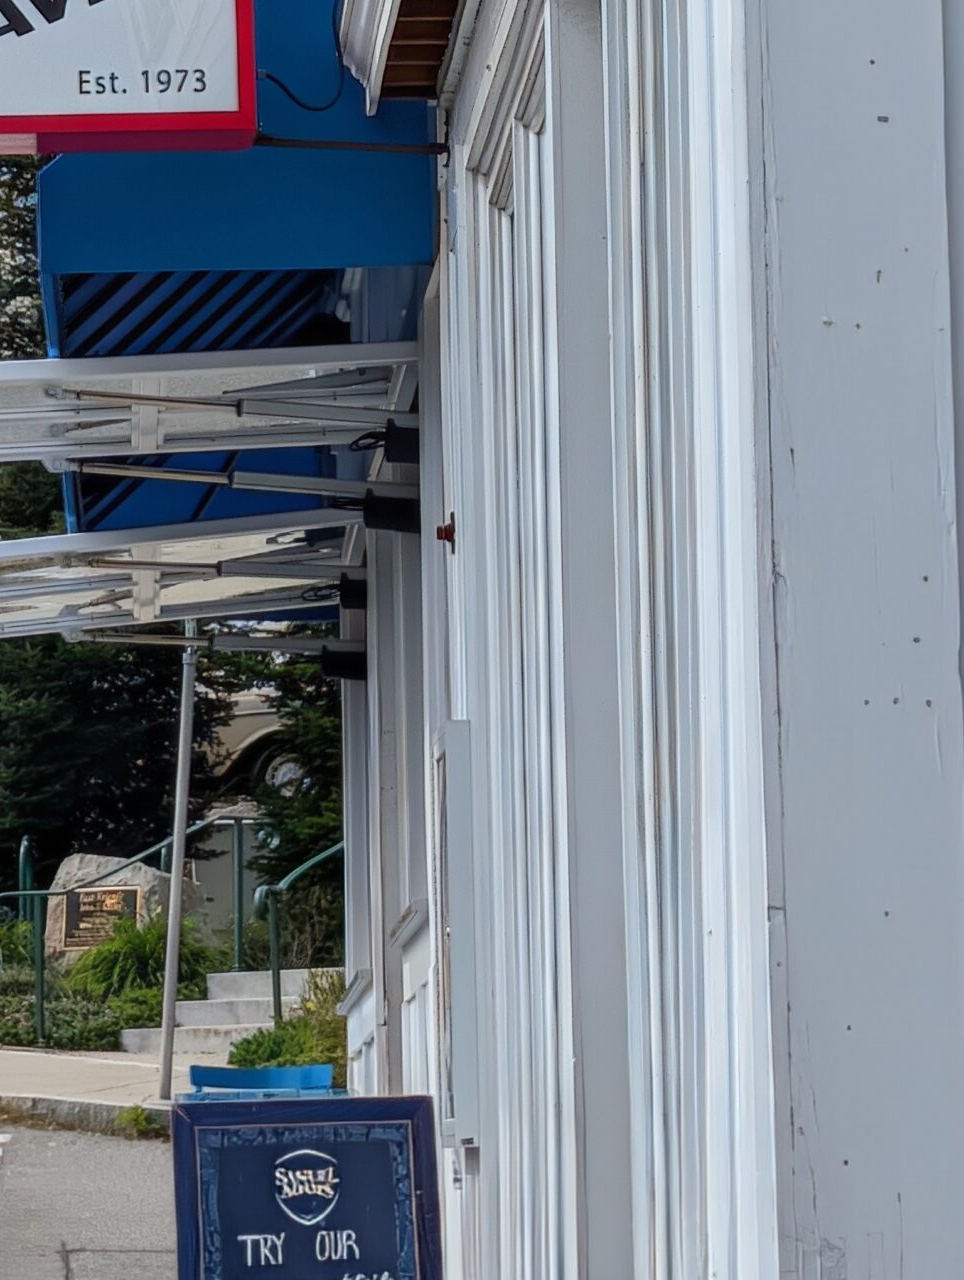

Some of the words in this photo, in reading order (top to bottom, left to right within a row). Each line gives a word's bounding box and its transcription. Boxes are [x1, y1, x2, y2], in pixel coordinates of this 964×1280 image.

[78, 70, 127, 94] Est.
[141, 69, 207, 93] 1973
[237, 1232, 285, 1267] TRY
[315, 1229, 360, 1261] OUR
